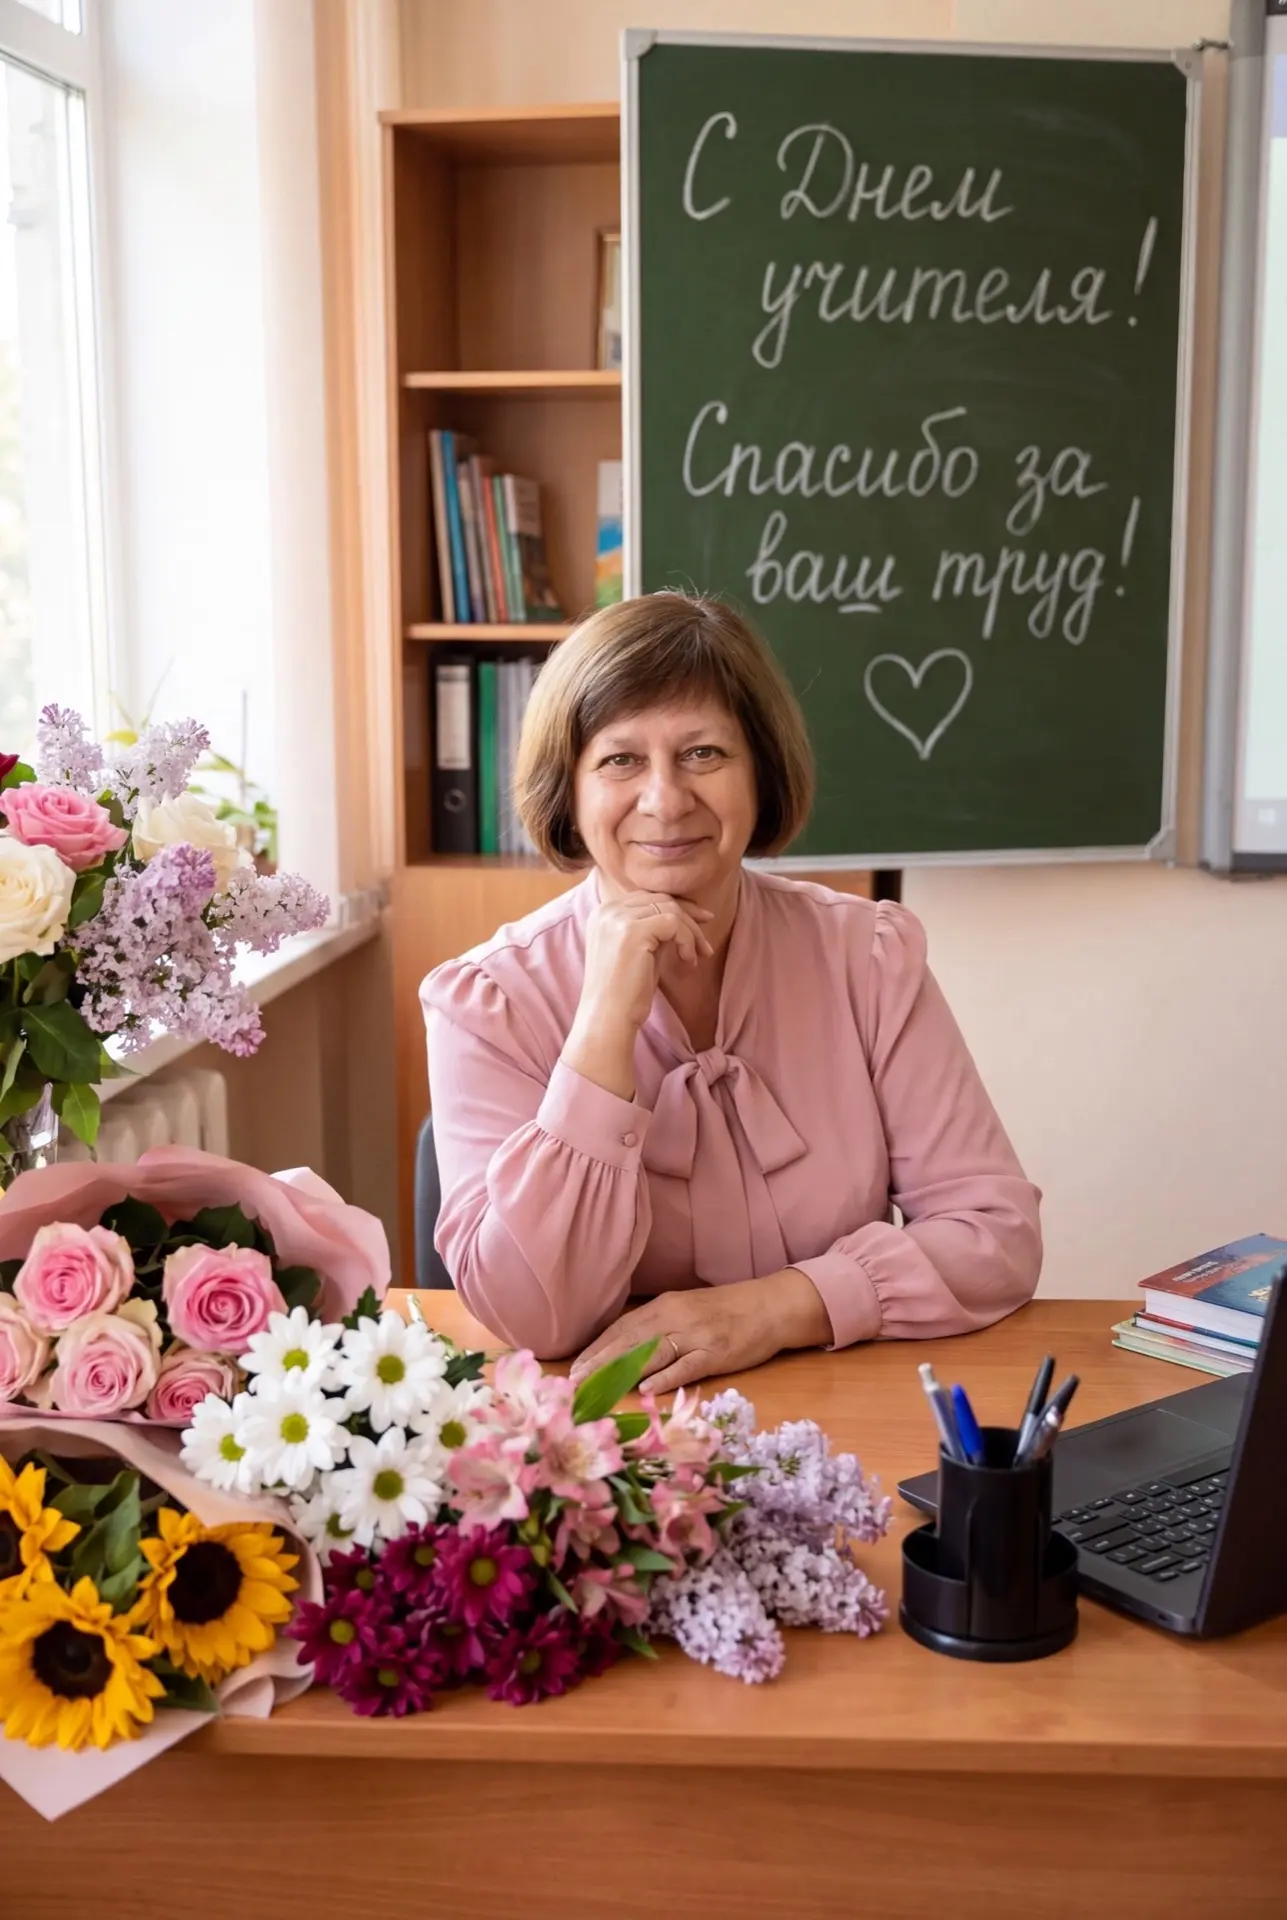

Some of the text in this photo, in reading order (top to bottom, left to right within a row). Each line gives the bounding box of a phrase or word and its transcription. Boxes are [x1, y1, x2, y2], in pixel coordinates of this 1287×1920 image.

[682, 111, 1013, 223] С Днем
[751, 216, 1158, 370] учителя!
[682, 400, 1107, 536] Спасибо за
[745, 495, 1141, 642] ваш труд!
